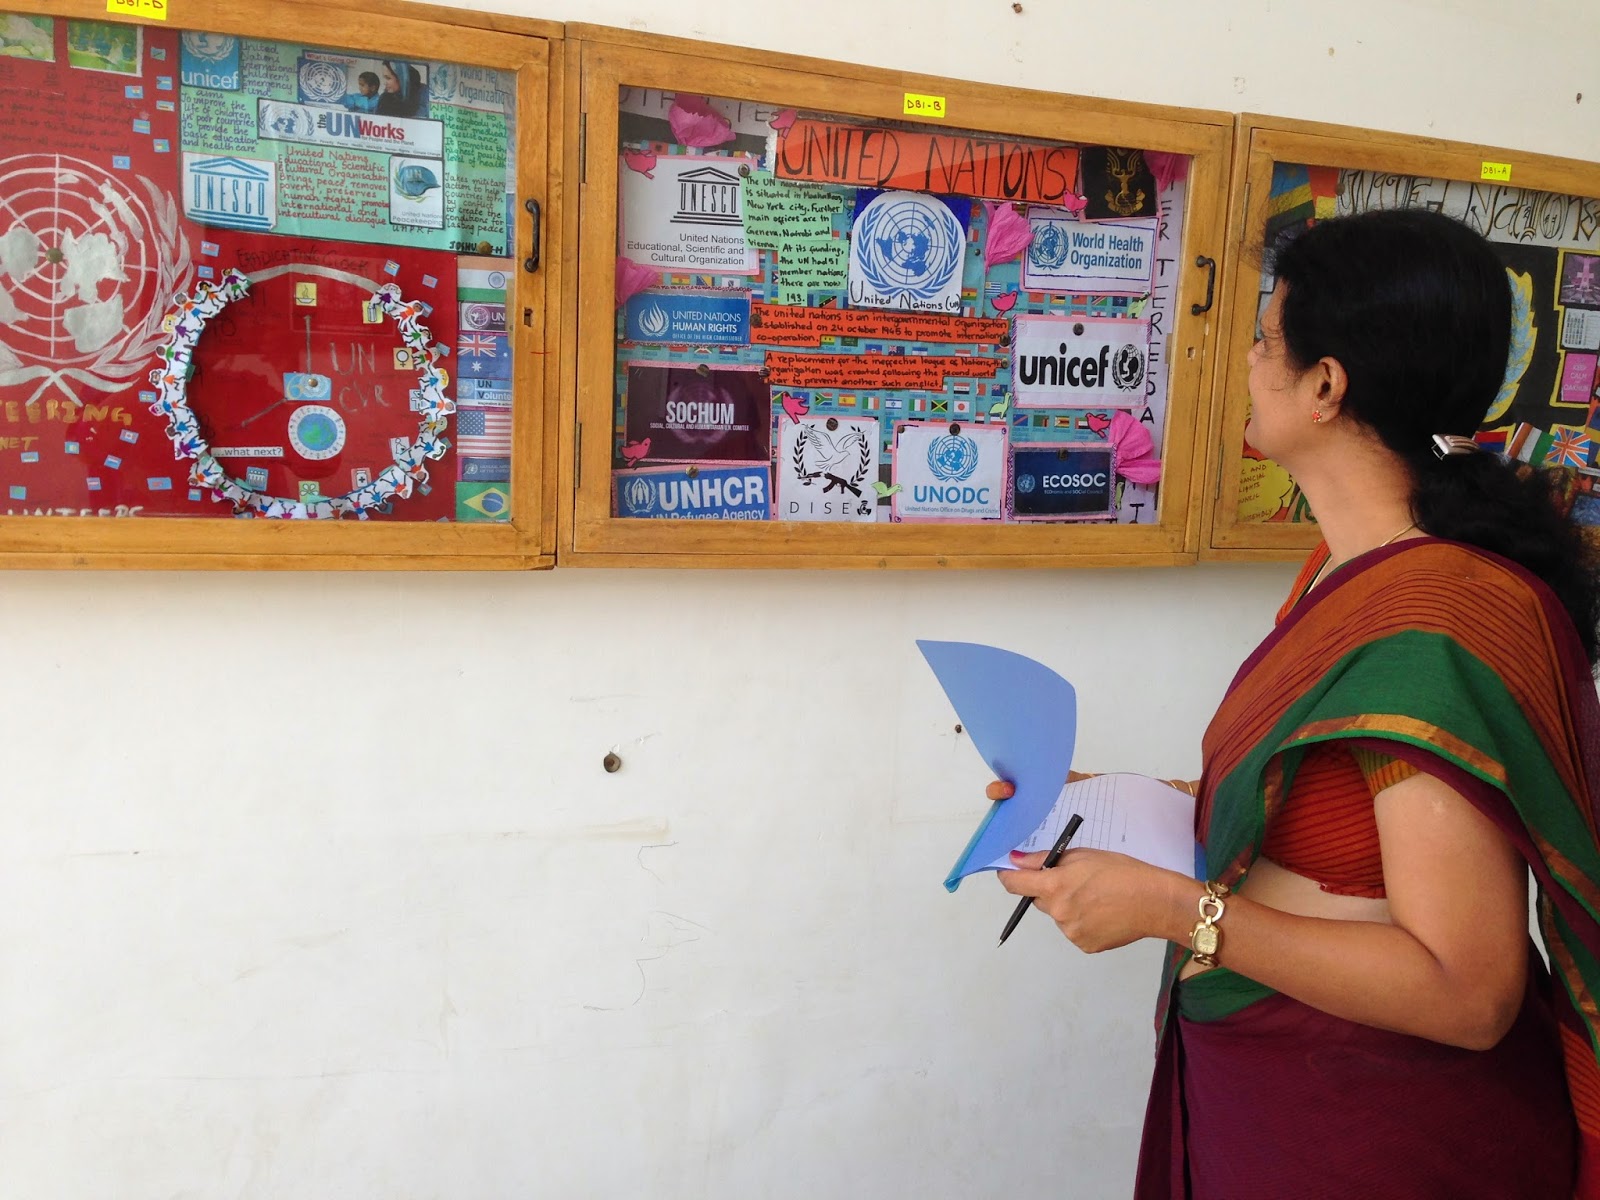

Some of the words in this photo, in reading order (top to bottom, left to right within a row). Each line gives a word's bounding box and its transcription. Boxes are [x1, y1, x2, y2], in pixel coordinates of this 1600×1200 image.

[182, 69, 239, 90] unicef
[231, 101, 246, 111] the
[317, 113, 327, 129] the
[234, 127, 249, 136] the
[213, 133, 259, 145] education
[202, 141, 234, 151] health
[286, 146, 325, 159] United
[329, 151, 369, 162] Nations
[781, 124, 900, 187] UNITED
[924, 136, 1067, 200] NATIONS
[351, 182, 387, 191] removes
[763, 178, 776, 187] UN
[194, 174, 266, 217] UNESCO
[327, 187, 377, 198] preserves
[680, 182, 737, 214] UNESCO
[746, 187, 754, 197] is
[756, 189, 791, 199] situated
[794, 190, 801, 198] in
[358, 208, 379, 218] and
[746, 199, 764, 210] New
[767, 201, 785, 211] York
[789, 203, 810, 216] city.
[811, 202, 841, 213] Further
[345, 215, 387, 228] dialogue
[748, 214, 770, 223] main
[773, 215, 800, 226] offices
[803, 215, 817, 223] are
[477, 225, 504, 237] peace
[782, 229, 812, 238] Nairobi
[815, 226, 831, 236] and
[679, 233, 708, 243] United
[711, 235, 744, 245] Nations
[1072, 231, 1105, 250] World
[1108, 234, 1144, 253] Health
[627, 240, 683, 253] Educational,
[685, 244, 727, 255] Scientific
[727, 247, 744, 255] and
[782, 243, 792, 253] At
[796, 244, 807, 253] its
[650, 252, 686, 263] Cultural
[688, 254, 744, 266] Organization
[779, 256, 794, 265] the
[798, 256, 810, 265] UN
[812, 257, 828, 265] had
[1070, 249, 1142, 270] Organization
[779, 267, 813, 276] member
[781, 277, 803, 287] there
[786, 292, 806, 303] 193.
[849, 279, 892, 306] United
[899, 292, 943, 310] Nations
[672, 310, 703, 321] UNITED
[704, 311, 742, 323] NATIONS
[754, 306, 770, 317] The
[774, 308, 806, 319] united
[809, 310, 842, 321] nations
[845, 311, 853, 321] is
[872, 312, 951, 327] intergovernmental
[672, 323, 706, 332] HUMAN
[708, 323, 738, 334] RIGHTS
[830, 323, 844, 332] 24
[847, 325, 879, 333] october
[905, 327, 912, 336] to
[916, 329, 953, 340] promote
[756, 333, 820, 344] co-operation.
[330, 342, 375, 376] UN
[766, 353, 773, 362] A
[777, 354, 835, 367] replacement
[837, 358, 850, 367] for
[851, 357, 868, 365] the
[872, 356, 918, 368] ineffective
[920, 356, 946, 367] league
[950, 359, 959, 368] of
[1019, 342, 1110, 389] unicef
[848, 368, 881, 376] created
[882, 367, 922, 379] following
[923, 368, 939, 377] the
[972, 368, 997, 377] world
[477, 380, 492, 389] UN
[793, 377, 802, 385] to
[804, 377, 839, 388] prevent
[841, 377, 878, 387] another
[477, 391, 512, 401] Volunte
[3, 399, 133, 426] EERING
[666, 401, 734, 425] SOCHUM
[254, 447, 282, 457] next?
[1251, 464, 1267, 473] AND
[1042, 472, 1107, 488] ECOSOC
[658, 474, 765, 512] UNHCR
[913, 485, 990, 505] UNODC
[722, 507, 765, 521] Agency
[961, 507, 974, 515] Drugs
